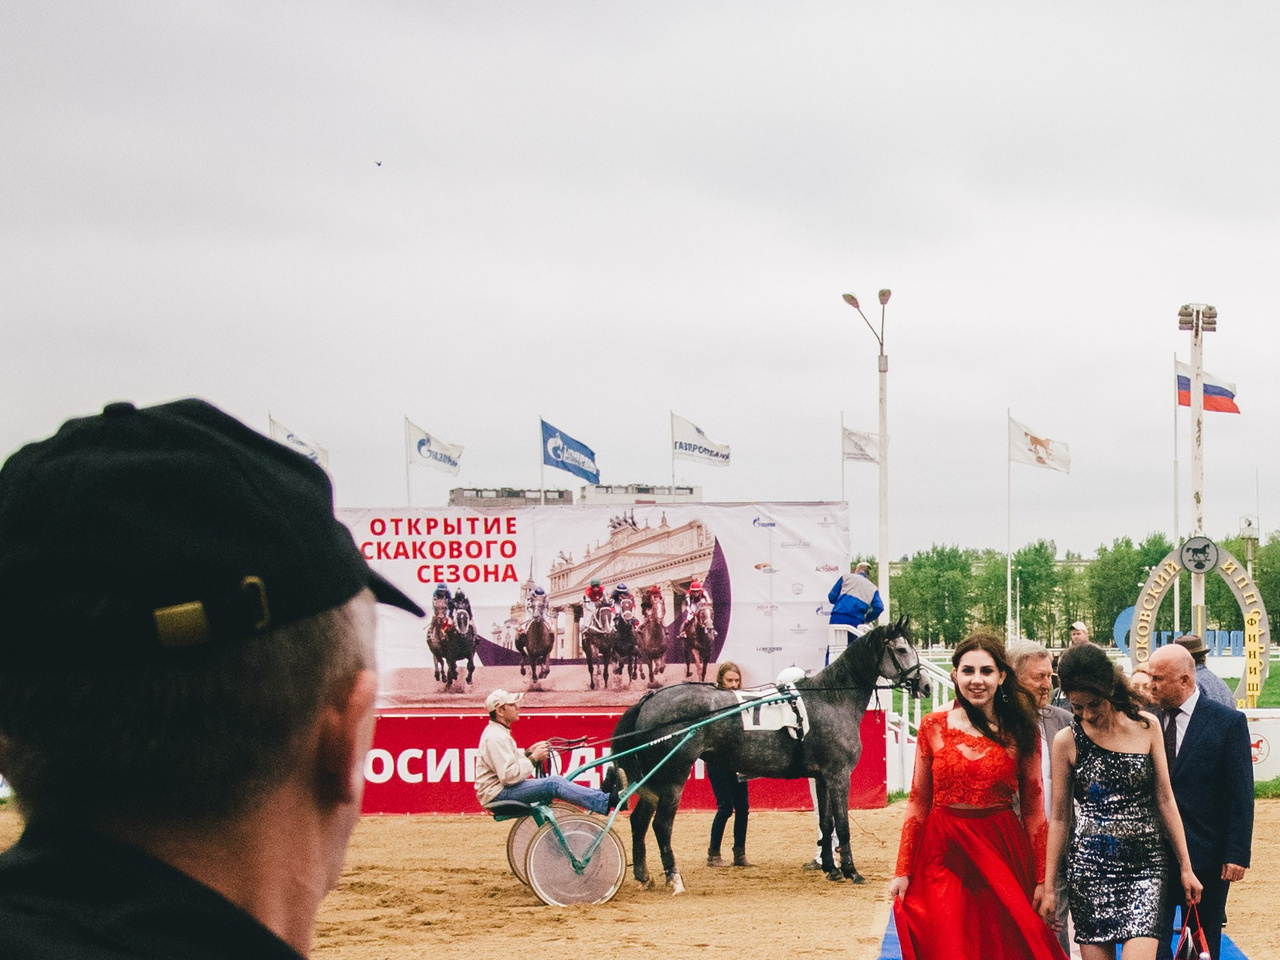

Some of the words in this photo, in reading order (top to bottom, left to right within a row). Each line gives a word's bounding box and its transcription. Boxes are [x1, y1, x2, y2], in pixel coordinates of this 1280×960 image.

[369, 517, 517, 536] ОТКРЫТИЕ
[360, 540, 517, 560] СКАКОВОГО
[416, 564, 519, 583] СЕЗОНА
[1136, 559, 1182, 663] СКОВСКИЙ
[1246, 617, 1259, 692] ФИНИШ
